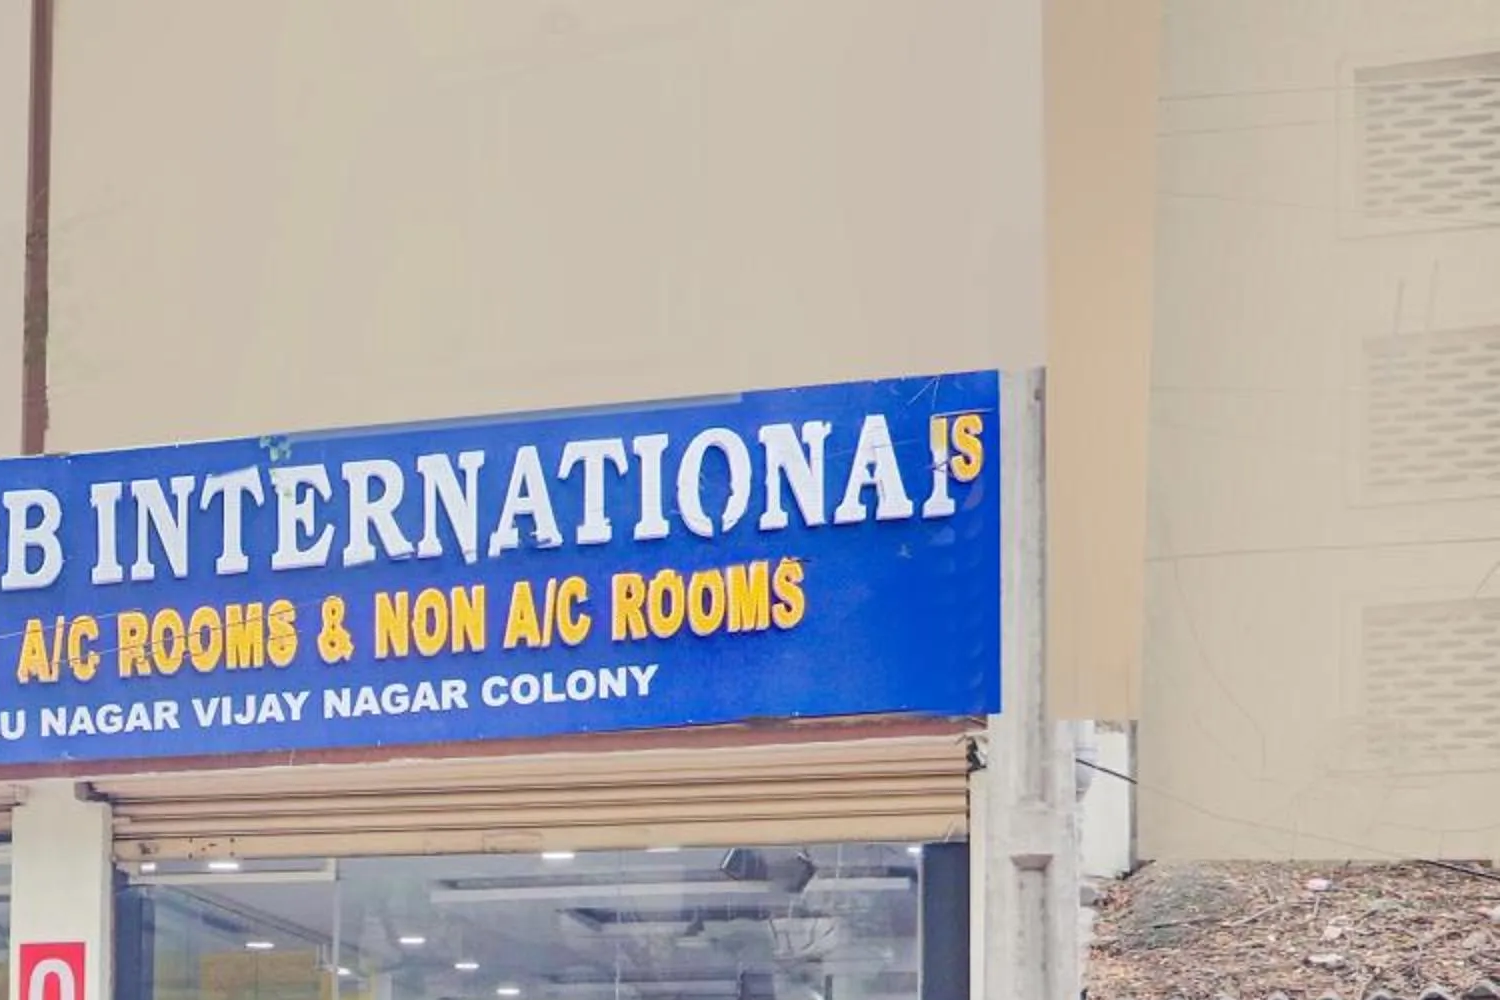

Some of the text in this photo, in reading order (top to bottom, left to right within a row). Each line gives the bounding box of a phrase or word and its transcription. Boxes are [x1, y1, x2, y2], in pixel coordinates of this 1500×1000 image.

[17, 614, 100, 684] A/C
[117, 599, 298, 679] ROOMS
[317, 596, 354, 664] &
[375, 584, 485, 660] NON
[503, 576, 591, 650] A/C
[611, 558, 806, 642] ROOMS
[40, 699, 180, 737] NAGAR
[192, 690, 312, 728] VIJAY
[323, 679, 468, 719] NAGAR
[481, 663, 659, 708] COLONY
